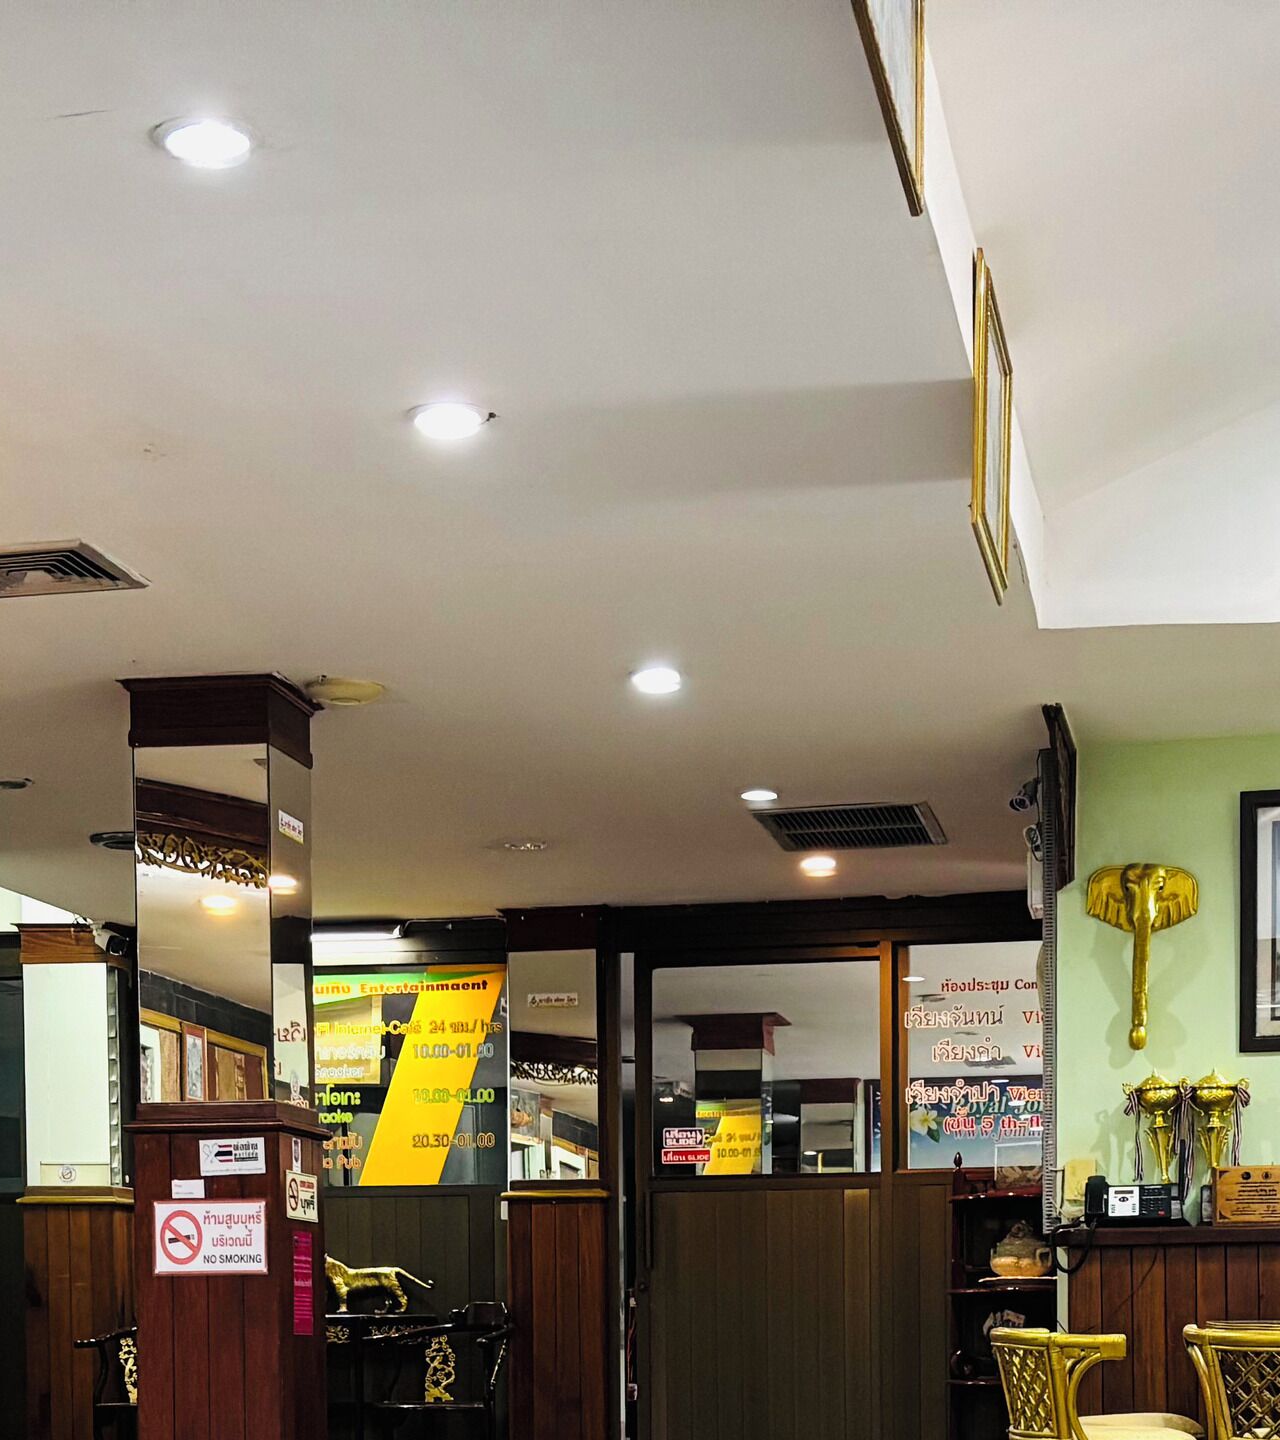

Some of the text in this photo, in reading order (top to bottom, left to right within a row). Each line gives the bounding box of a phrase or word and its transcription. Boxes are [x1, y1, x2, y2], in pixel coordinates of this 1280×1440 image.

[940, 977, 1038, 995] ห้องประชุม Con
[904, 1004, 1005, 1029] เวียงจันทน์
[429, 1020, 446, 1034] 24
[931, 1037, 1003, 1063] เวียงคำ
[905, 1078, 1000, 1105] เวียงจำปา
[319, 1109, 354, 1124] raoke
[980, 1113, 995, 1130] 5
[411, 1132, 496, 1148] 20.30-01.00
[336, 1153, 362, 1170] Pub
[203, 1205, 262, 1230] ห้ามสูบบุหรี่
[212, 1229, 253, 1247] บริเวณนี้
[203, 1254, 262, 1264] NO SMOKING
